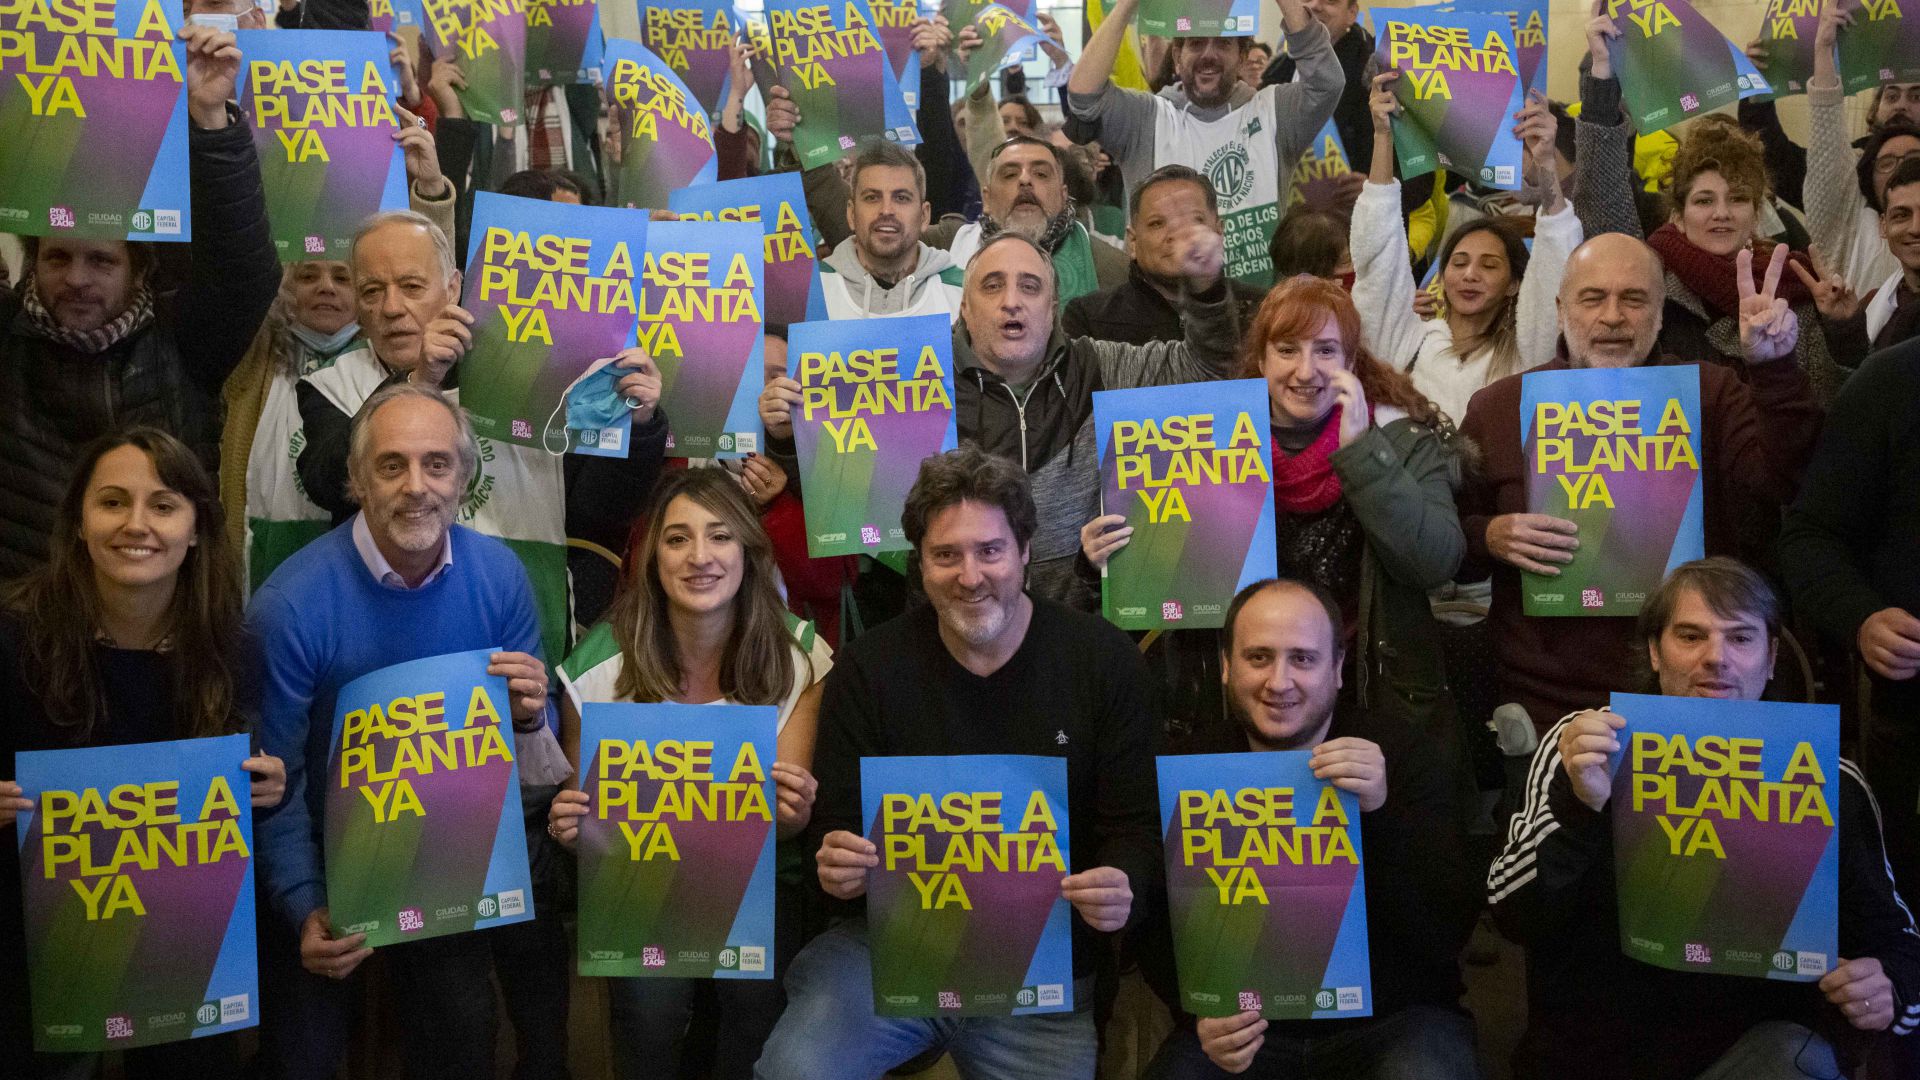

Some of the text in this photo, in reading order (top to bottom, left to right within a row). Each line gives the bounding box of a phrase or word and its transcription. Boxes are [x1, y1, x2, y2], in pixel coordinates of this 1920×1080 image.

[134, 0, 175, 41] A
[526, 7, 553, 27] YA
[646, 7, 731, 31] PASE A
[770, 2, 869, 38] PASE A
[1627, 2, 1682, 38] YA
[1771, 17, 1798, 40] YA
[1860, 0, 1904, 21] YA
[0, 30, 184, 83] PLANTA
[457, 27, 500, 60] YA
[649, 27, 732, 50] PLANTA
[775, 27, 883, 66] PLANTA
[1388, 21, 1472, 48] PASE
[1483, 31, 1509, 53] A
[250, 60, 387, 95] PASE A
[660, 47, 690, 70] YA
[791, 62, 836, 91] YA
[1390, 41, 1518, 76] PLANTA
[16, 73, 87, 118] YA
[614, 58, 686, 110] PASE
[1406, 70, 1453, 100] YA
[255, 94, 398, 129] PLANTA
[275, 129, 330, 163] YA
[776, 201, 803, 233] A
[1237, 206, 1278, 228] DE LOS
[484, 227, 635, 278] PASE A
[1223, 226, 1264, 248] RECHOS
[642, 252, 755, 288] ASE A
[1224, 256, 1273, 278] LESCENT
[480, 265, 637, 315] PLANTA
[640, 288, 762, 323] LANTA
[498, 304, 553, 345] YA
[637, 322, 684, 358] YA
[801, 346, 945, 387] PASE A
[802, 378, 952, 421] PLANTA
[1536, 398, 1691, 438] PASE A
[822, 417, 878, 454] YA
[1113, 411, 1262, 455] PASE A
[1116, 448, 1270, 490] PLANTA
[1537, 434, 1700, 474] PLANTA
[1136, 487, 1192, 524] YA
[1556, 473, 1615, 510] YA
[342, 686, 501, 749] PASE A
[340, 725, 514, 788] PLANTA
[599, 739, 766, 782] PASE A
[1632, 732, 1826, 784] PASE A
[41, 776, 241, 834] PASE A
[359, 779, 426, 824] YA
[598, 780, 773, 822] PLANTA
[882, 790, 1058, 833] PASE A
[1179, 786, 1350, 828] PASE A
[1632, 773, 1835, 827] PLANTA
[43, 818, 250, 879] PLANTA
[618, 821, 681, 861] YA
[884, 832, 1067, 873] PLANTA
[1182, 826, 1360, 867] PLANTA
[1655, 815, 1727, 859] YA
[69, 874, 147, 921] YA
[907, 872, 973, 910] YA
[1204, 867, 1270, 905] YA
